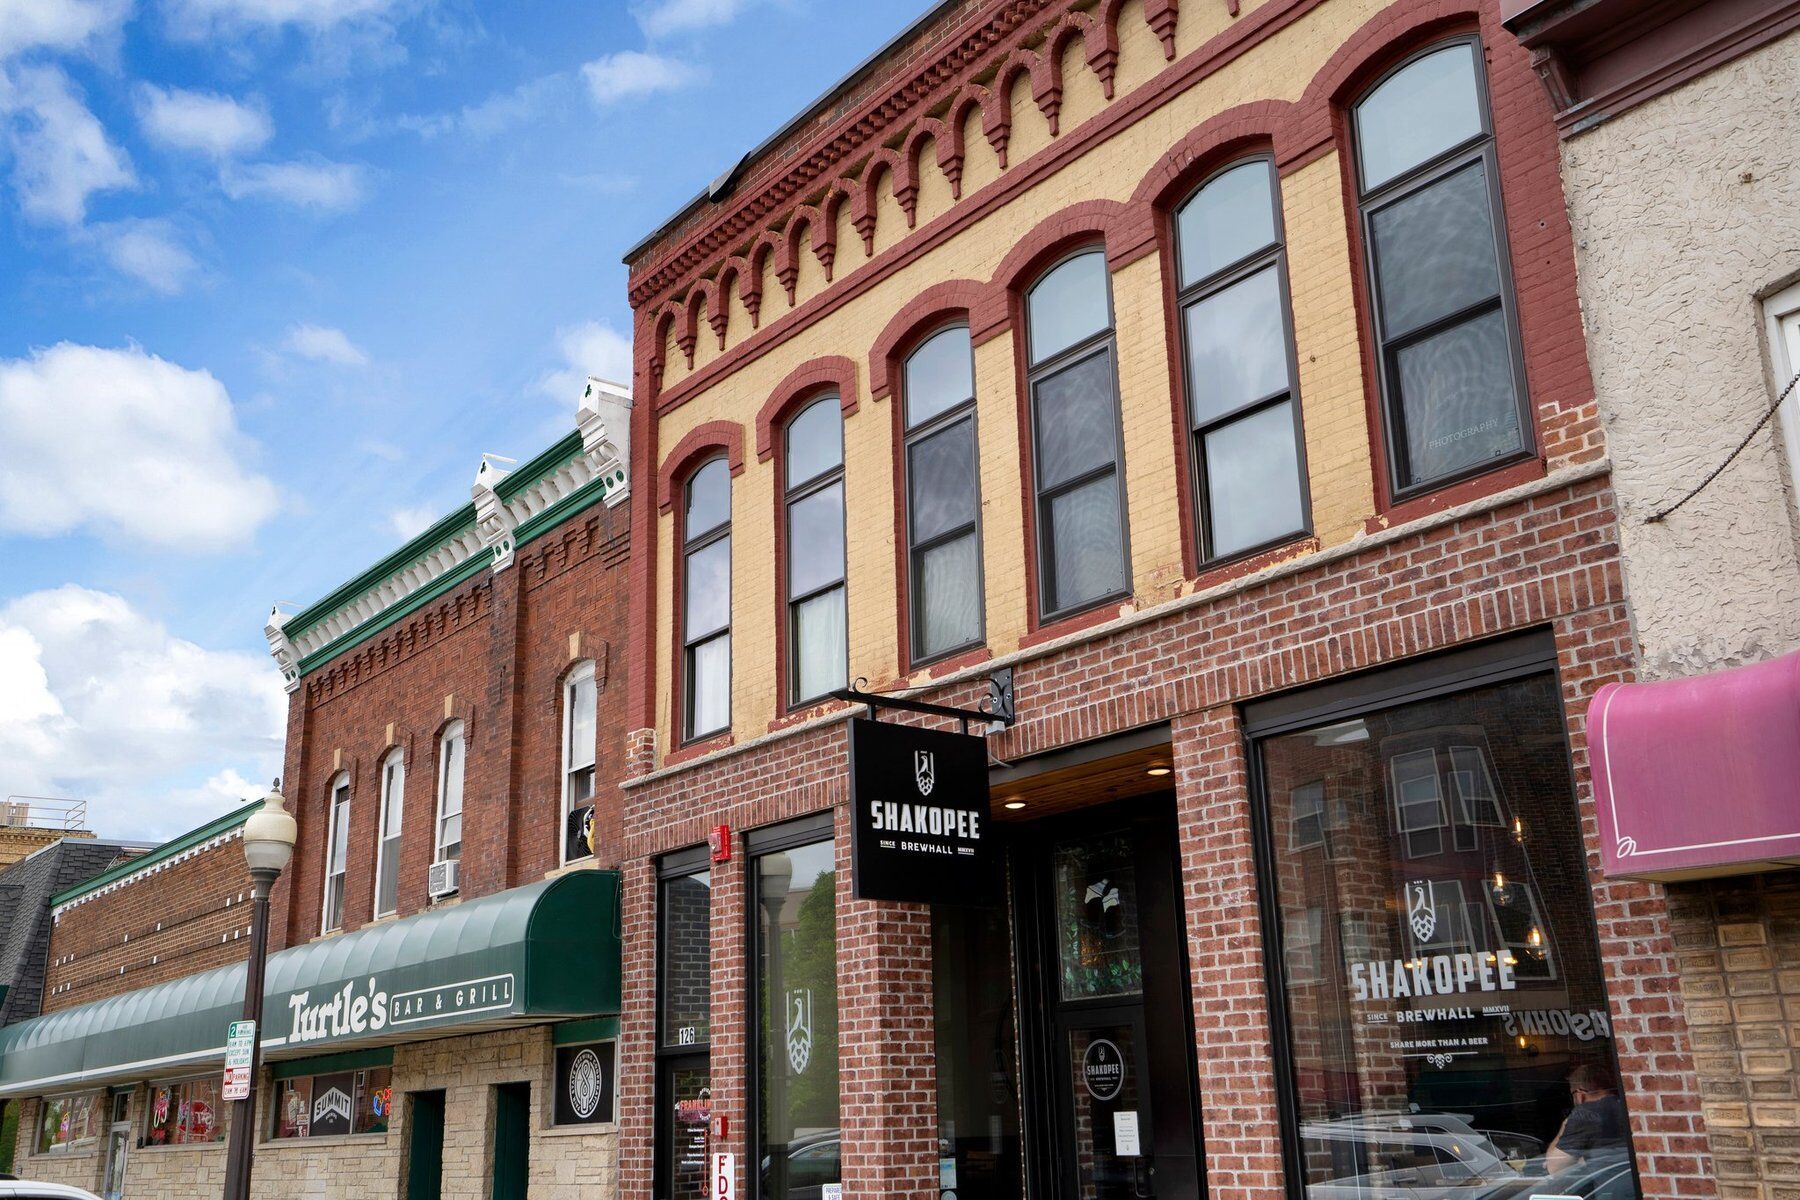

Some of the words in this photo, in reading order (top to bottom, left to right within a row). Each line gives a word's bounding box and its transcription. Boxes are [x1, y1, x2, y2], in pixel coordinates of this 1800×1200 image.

[1428, 417, 1498, 450] PHOTOGRAPHY
[870, 799, 981, 840] SHAKOPEE
[879, 839, 896, 847] SINCE
[901, 841, 953, 855] BREWHALL
[1351, 949, 1516, 1001] SHAKOPEE
[288, 976, 387, 1043] Turtle's
[393, 997, 424, 1017] BAR
[435, 994, 443, 1010] &
[455, 982, 511, 1007] GRILL
[1366, 1012, 1388, 1022] SINCE
[1396, 1006, 1475, 1023] BREWHALL
[1482, 1004, 1510, 1014] MMXVII
[230, 1026, 236, 1038] 2
[680, 1027, 694, 1044] 126
[1390, 1040, 1415, 1049] SHARE
[1415, 1039, 1437, 1048] MORE
[1438, 1038, 1460, 1047] THAN
[1461, 1038, 1468, 1046] A
[1468, 1037, 1488, 1046] BEER
[1087, 1063, 1120, 1076] SHAKOPEE
[316, 1091, 349, 1116] SUMMIT
